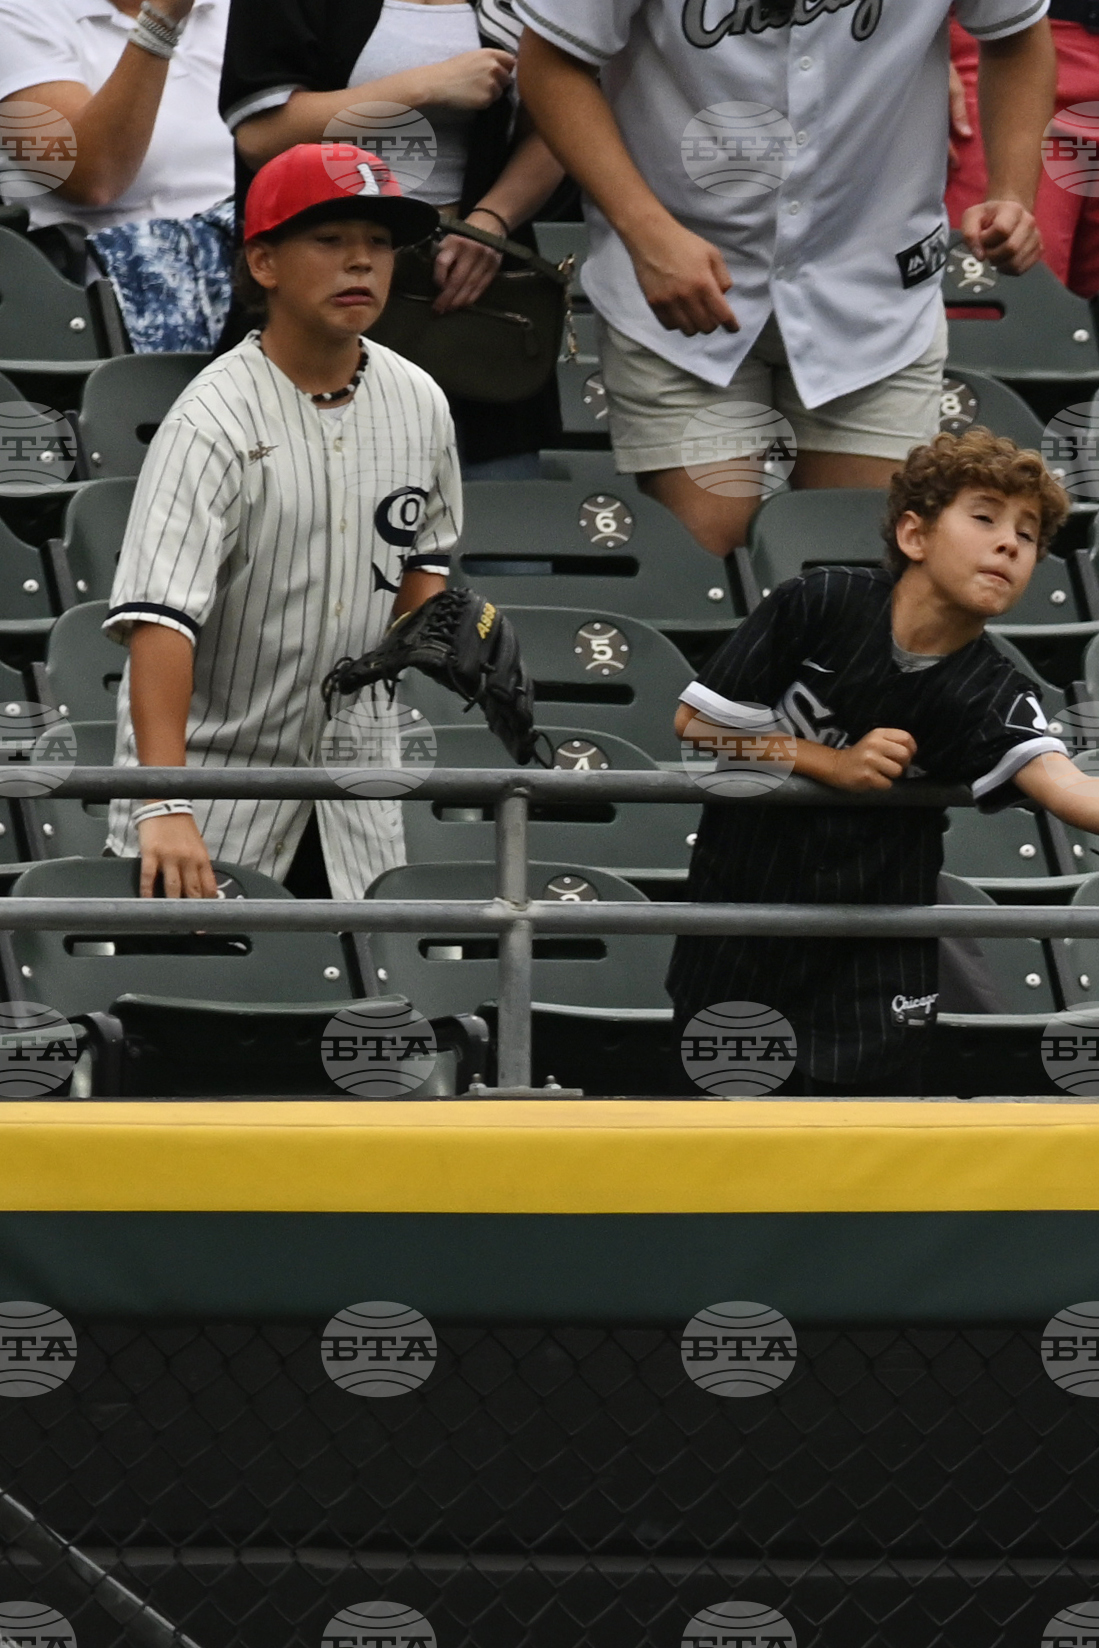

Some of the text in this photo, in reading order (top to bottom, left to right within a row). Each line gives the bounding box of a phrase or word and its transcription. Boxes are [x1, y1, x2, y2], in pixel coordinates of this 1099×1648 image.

[962, 259, 983, 280] 9
[941, 393, 962, 416] 8
[595, 511, 617, 533] 6
[591, 640, 613, 661] 5
